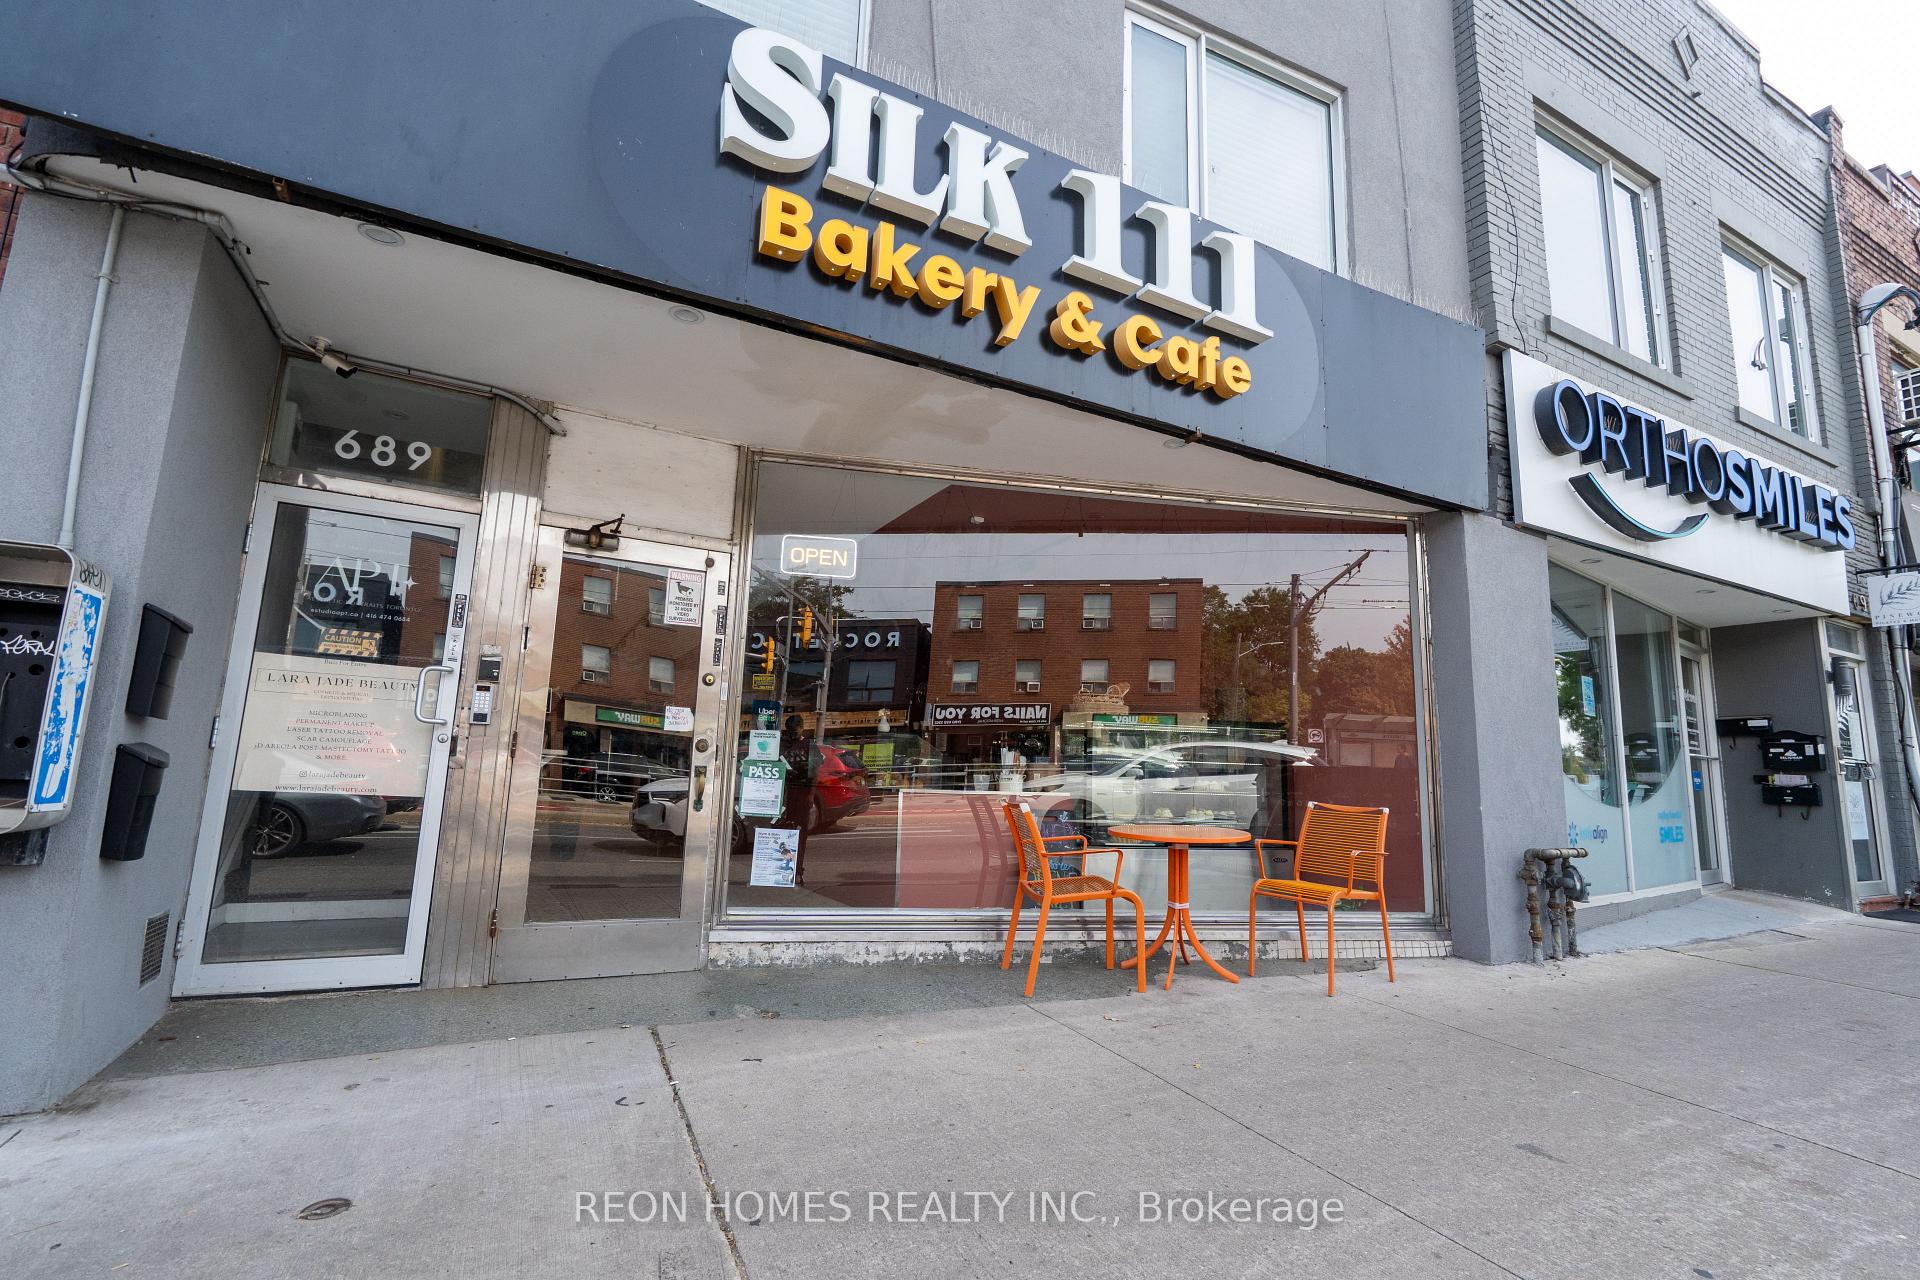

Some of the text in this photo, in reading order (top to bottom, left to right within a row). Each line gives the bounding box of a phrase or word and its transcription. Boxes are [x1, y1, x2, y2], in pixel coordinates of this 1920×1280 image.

[720, 27, 1032, 257] SILK
[758, 185, 1252, 399] Bakery & Cafe
[335, 429, 432, 471] 689
[1534, 378, 1857, 552] ORTHOSMILES
[790, 547, 848, 567] OPEN
[671, 571, 703, 583] WARNING
[324, 634, 362, 645] CAUTION
[267, 672, 310, 684] LARA
[317, 675, 353, 688] JADE
[309, 709, 368, 718] MICROBLADING
[758, 707, 776, 715] Uber
[295, 718, 375, 728] PERMANENT MAKEUP
[313, 727, 347, 735] TATTOO
[347, 729, 383, 737] REMOVAL
[296, 735, 373, 745] SCAR CAMOUFLAGE
[748, 766, 780, 779] PASS
[274, 784, 378, 794] www.larajadebeauty.com
